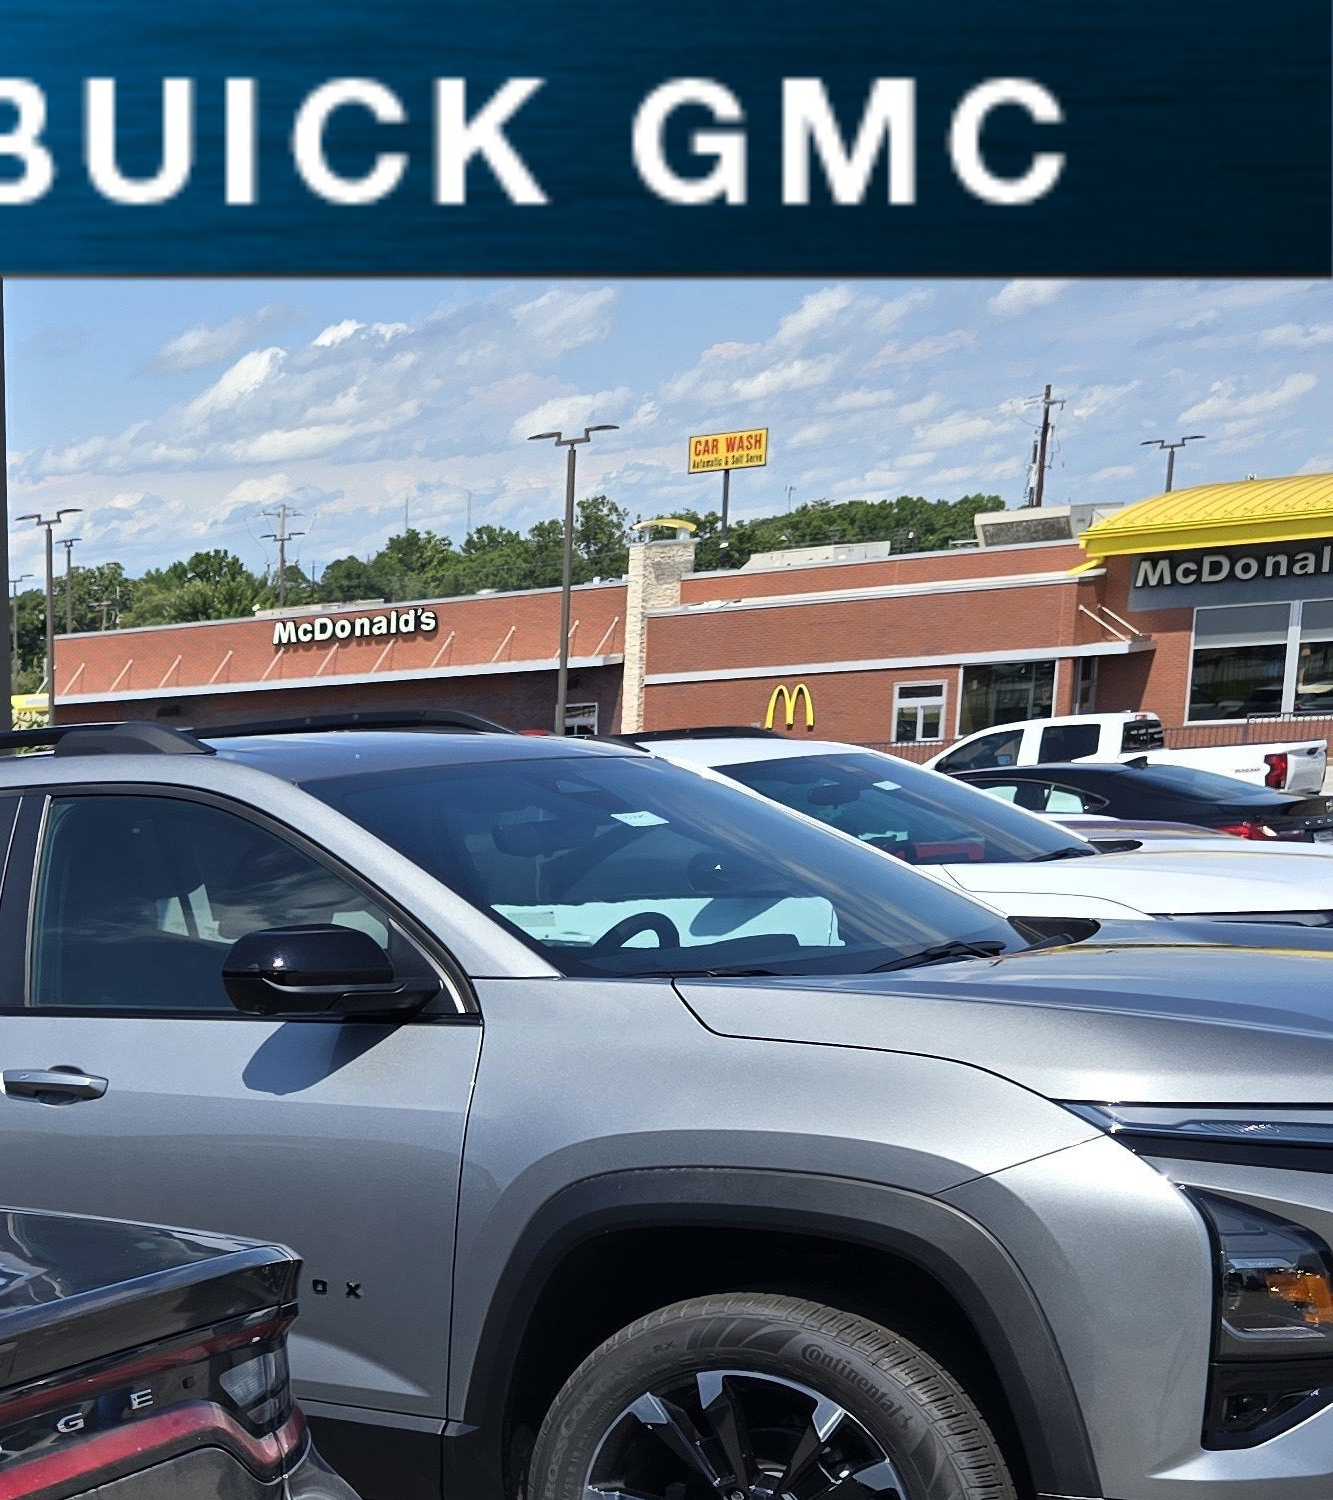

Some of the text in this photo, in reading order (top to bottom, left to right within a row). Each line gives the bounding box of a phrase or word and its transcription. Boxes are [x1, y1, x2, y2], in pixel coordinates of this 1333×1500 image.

[694, 433, 763, 456] CAR WASH
[272, 607, 437, 645] McDonald's
[801, 1343, 903, 1421] Continental
